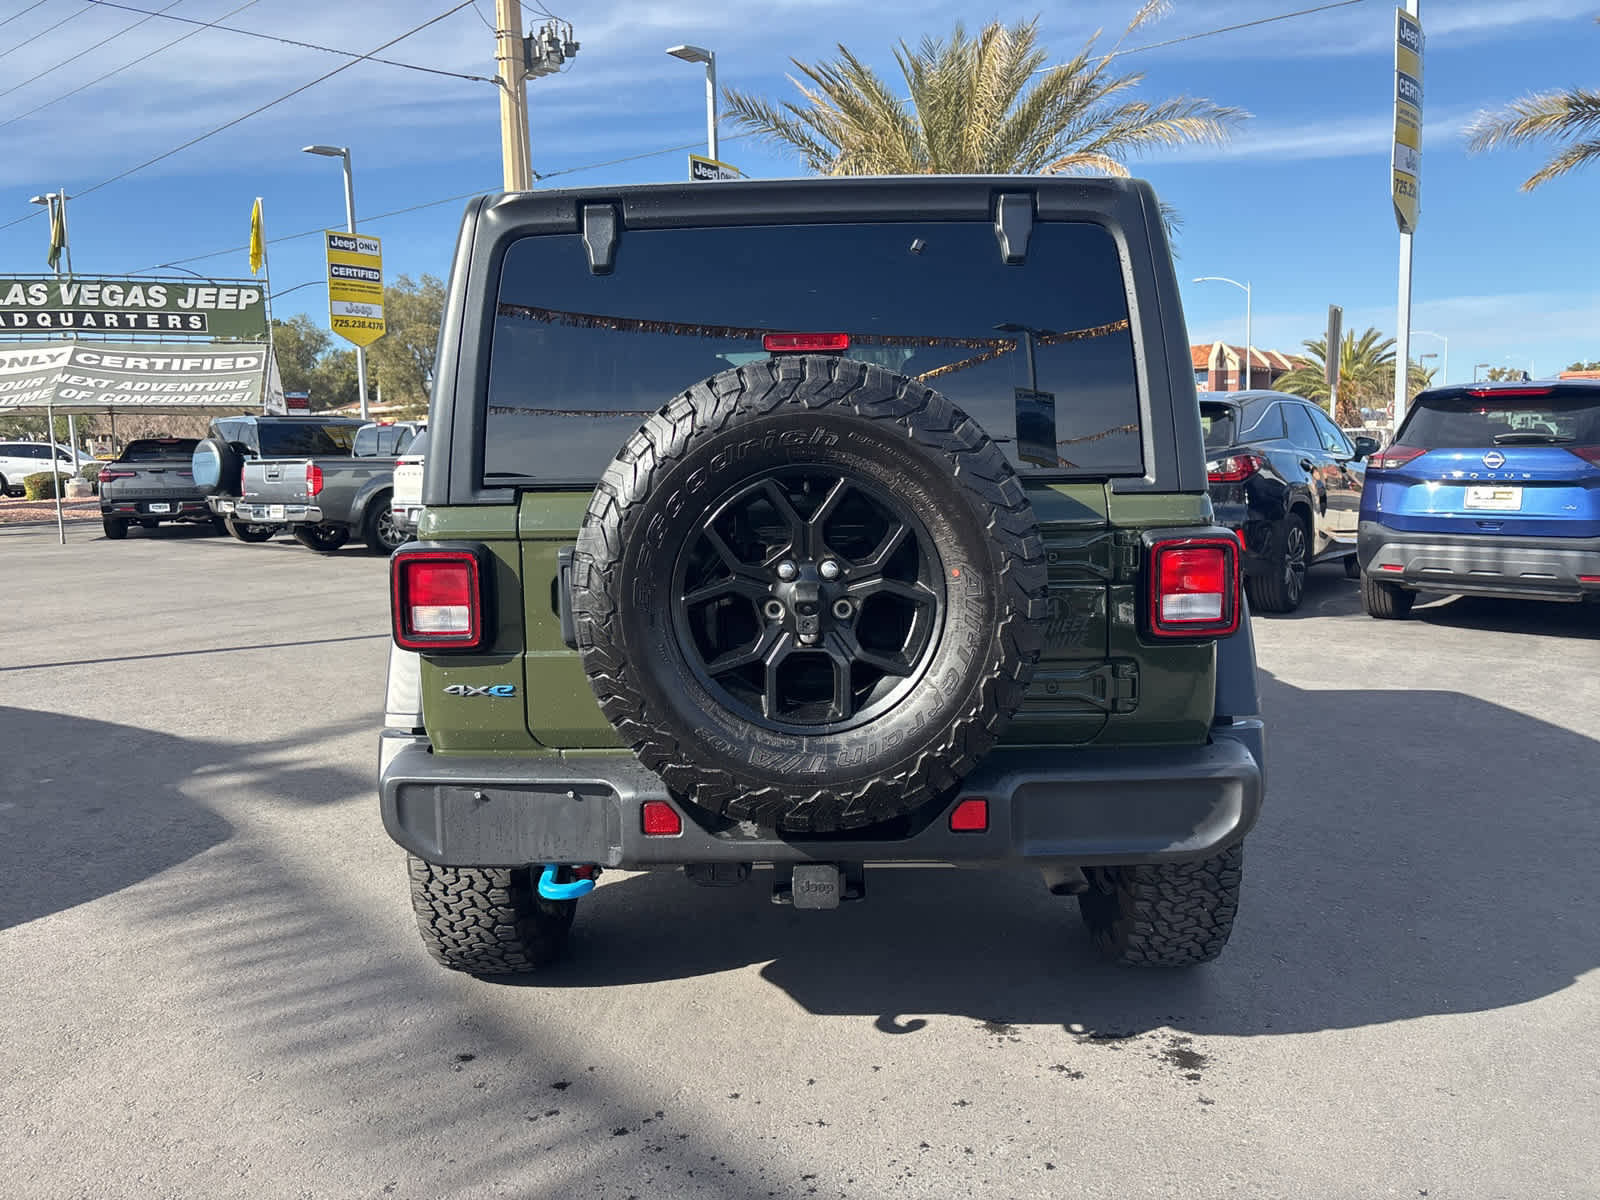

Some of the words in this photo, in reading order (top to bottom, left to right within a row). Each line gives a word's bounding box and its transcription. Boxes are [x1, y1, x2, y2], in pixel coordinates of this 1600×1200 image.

[331, 237, 356, 251] Jeep
[358, 241, 378, 251] ONLY
[332, 266, 380, 280] CERTIFIED
[60, 284, 168, 308] VEGAS
[178, 287, 260, 310] JEEP
[75, 353, 259, 371] CERTIFIED
[50, 373, 115, 389] NEXT
[115, 379, 252, 393] ADVENTURE
[59, 388, 94, 400] OF
[97, 392, 252, 404] CONFIDENCE!
[801, 880, 834, 894] Jeep
